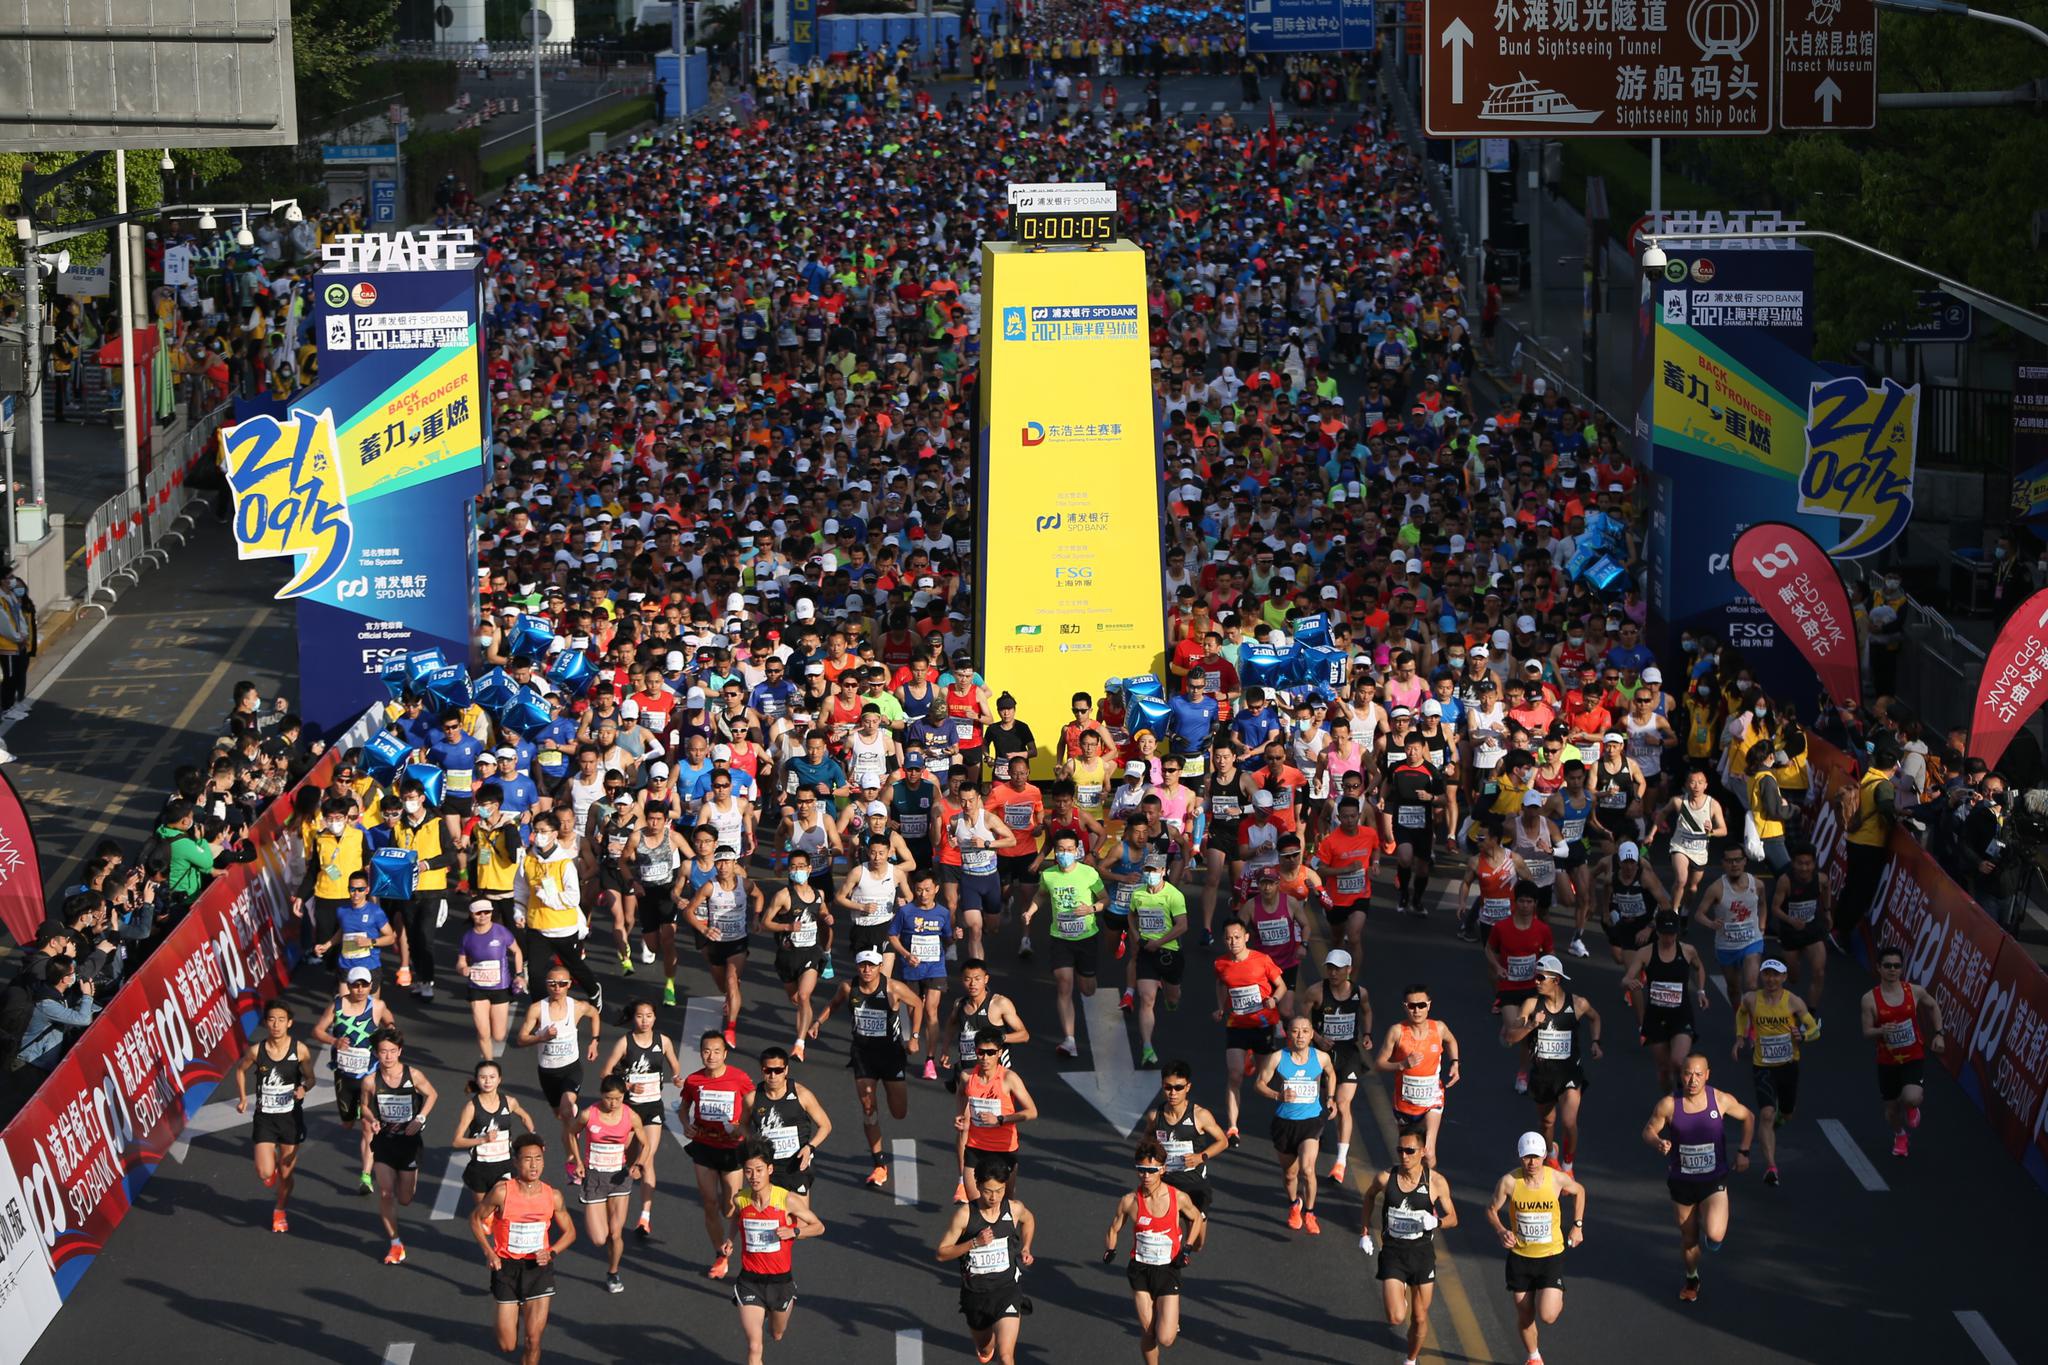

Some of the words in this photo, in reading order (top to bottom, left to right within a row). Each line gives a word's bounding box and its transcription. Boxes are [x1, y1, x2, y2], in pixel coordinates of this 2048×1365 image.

[1494, 0, 1668, 32] 外滩观光隧道
[1273, 16, 1340, 32] 国际会议中心
[1344, 18, 1370, 27] Parking
[1499, 37, 1531, 55] Bund
[1537, 37, 1613, 60] Sightseeing
[1619, 37, 1662, 55] Tunnel
[1785, 30, 1874, 57] 大自然昆虫馆
[1786, 59, 1822, 72] Insect
[1828, 59, 1873, 72] Museum
[1616, 65, 1758, 101] 游船码头
[1616, 106, 1689, 128] Sightseeing
[1695, 105, 1723, 127] Ship
[1728, 105, 1757, 123] Dock
[1037, 197, 1071, 206] 浦发银行
[1073, 197, 1088, 205] SPD
[1089, 196, 1112, 205] BANK
[380, 207, 391, 219] P
[1024, 217, 1111, 239] 0:00:05
[1714, 293, 1753, 302] 浦发银行
[1757, 294, 1773, 302] SPD
[1774, 294, 1800, 302] BANK
[1052, 308, 1090, 318] 浦发银行
[1092, 308, 1111, 317] SPD
[1111, 307, 1136, 316] BANK
[378, 316, 416, 326] 浦发银行
[420, 316, 439, 325] SPD
[440, 314, 465, 323] BANK
[1698, 355, 1727, 381] BACK
[407, 373, 469, 415] STRONGER
[2014, 395, 2033, 404] 4.18
[388, 391, 419, 415] BACK
[1714, 380, 1773, 425] STRONGER
[1048, 423, 1122, 436] 东浩兰生赛事
[1067, 512, 1109, 523] 浦发银行
[1068, 523, 1084, 532] SPD
[1085, 523, 1108, 531] BANK
[376, 558, 403, 568] Sponsor
[1055, 567, 1093, 578] FSG
[374, 575, 427, 589] 浦发银行
[1056, 580, 1092, 588] 上海外服
[376, 589, 398, 600] SPD
[397, 588, 425, 599] BANK
[529, 622, 549, 633] 1:30
[1060, 623, 1081, 635] 魔力
[1298, 621, 1319, 632] 2:00
[1729, 623, 1774, 638] FSG
[358, 631, 382, 640] Official
[382, 630, 411, 640] Sponsor
[1253, 648, 1275, 657] 2:00
[2015, 635, 2040, 666] SPD
[385, 663, 405, 673] 1:45
[558, 653, 573, 674] 1:45
[432, 670, 455, 680] 1:45
[1330, 662, 1338, 685] 2:00
[1132, 676, 1154, 684] 2:00
[1999, 647, 2048, 723] 浦发银行
[1984, 664, 2019, 711] BANK
[531, 697, 551, 715] 1:45
[374, 738, 398, 759] 1:45
[380, 850, 406, 860] 1:30
[1054, 887, 1075, 895] TIME
[1888, 868, 1929, 940] 浦发银行
[1059, 922, 1063, 930] A
[1140, 919, 1145, 928] A
[1261, 931, 1267, 939] A
[1727, 932, 1732, 940] A
[913, 946, 918, 954] A
[1943, 929, 1992, 1008] 浦发银行
[175, 940, 223, 1020] 浦发银行
[1936, 982, 1955, 1023] SPD
[1949, 1000, 1973, 1049] BANK
[195, 1013, 217, 1058] SPD
[213, 994, 236, 1040] BANK
[857, 1018, 862, 1028] A
[864, 1018, 885, 1030] 15026
[1326, 1023, 1331, 1033] A
[1539, 1042, 1545, 1050] A
[1546, 1041, 1569, 1052] 15038
[1763, 1047, 1769, 1056] A
[114, 1009, 163, 1098] 浦发银行
[338, 1056, 344, 1066] A
[1404, 1087, 1410, 1096] A
[1993, 1055, 2015, 1097] SPD
[2009, 1075, 2037, 1127] BANK
[135, 1093, 157, 1138] SPD
[152, 1066, 176, 1120] BANK
[380, 1107, 387, 1116] A
[388, 1105, 411, 1117] 15029
[701, 1104, 707, 1113] A
[709, 1103, 732, 1114] 10478
[47, 1088, 102, 1184] 浦发银行
[773, 1139, 797, 1151] 5045
[1681, 1157, 1688, 1167] A
[1689, 1154, 1714, 1167] 10792
[69, 1179, 94, 1227] SPD
[88, 1147, 117, 1206] BANK
[1517, 1225, 1523, 1234] A
[1524, 1224, 1550, 1237] 10839
[971, 1255, 978, 1267] A
[981, 1252, 1006, 1266] 10922
